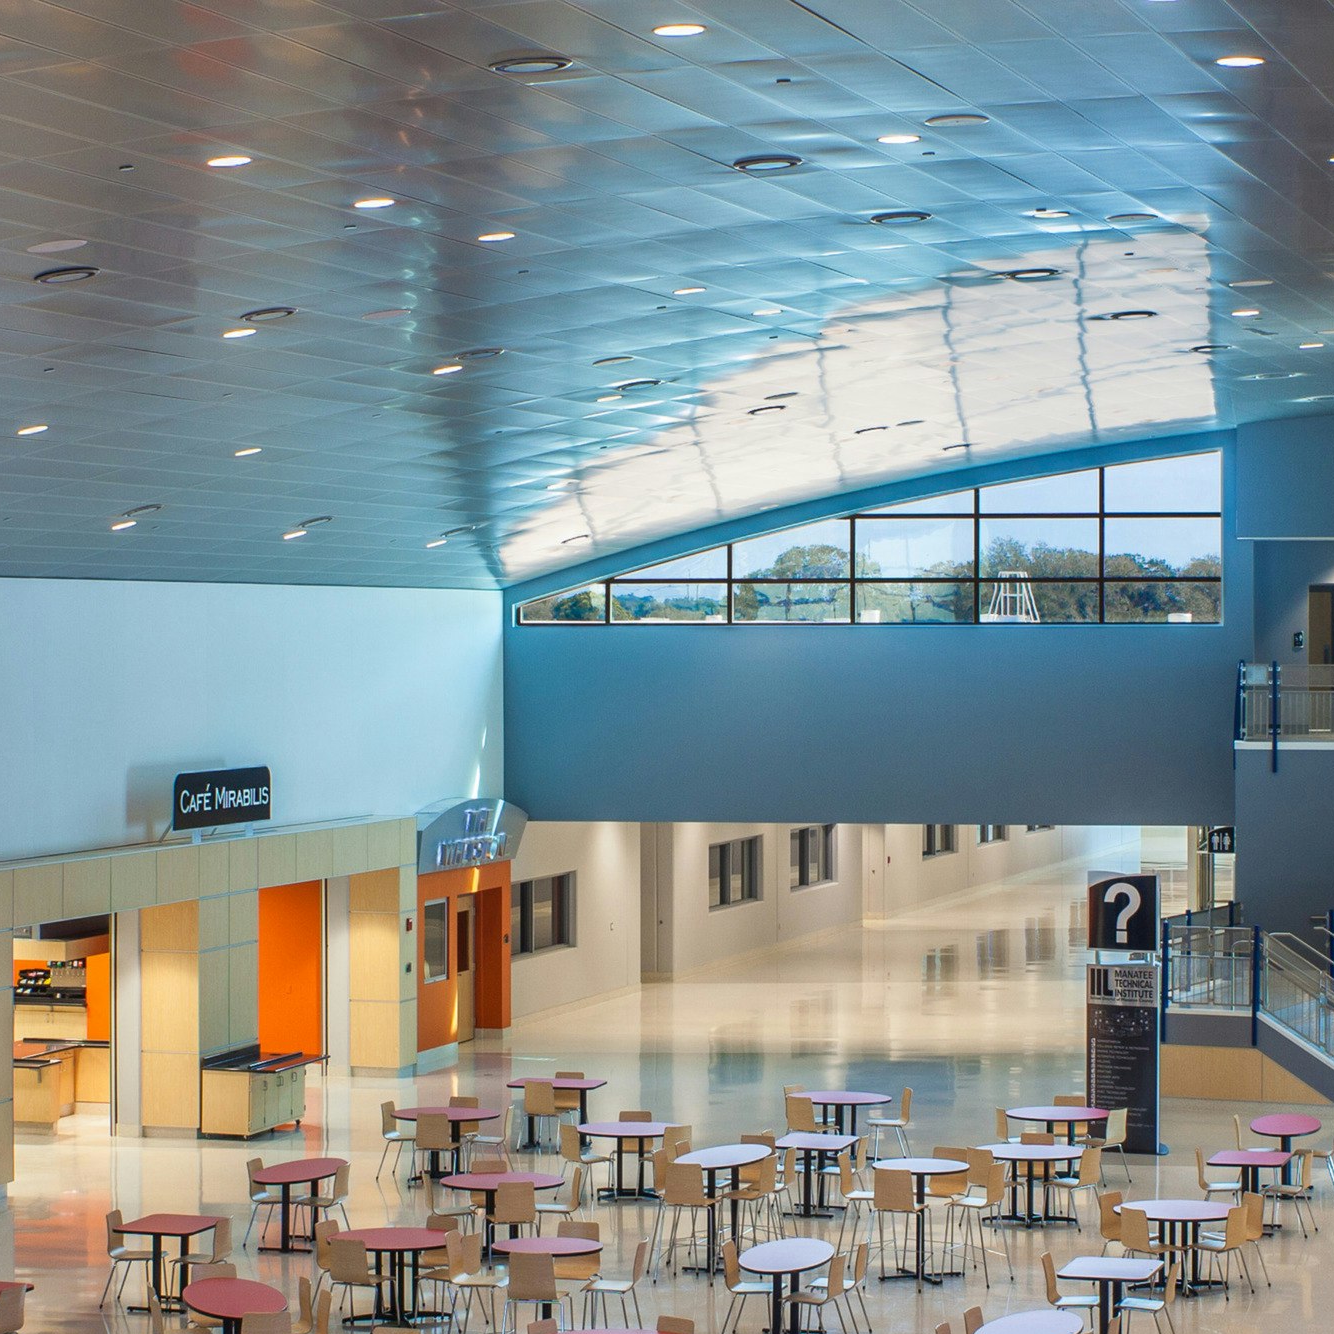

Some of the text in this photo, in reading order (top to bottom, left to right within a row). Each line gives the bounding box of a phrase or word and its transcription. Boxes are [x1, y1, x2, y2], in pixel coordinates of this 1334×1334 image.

[1114, 970, 1154, 979] MANATEE
[1114, 979, 1154, 989] TECHNICAL
[1114, 989, 1154, 998] INSTITUTE
